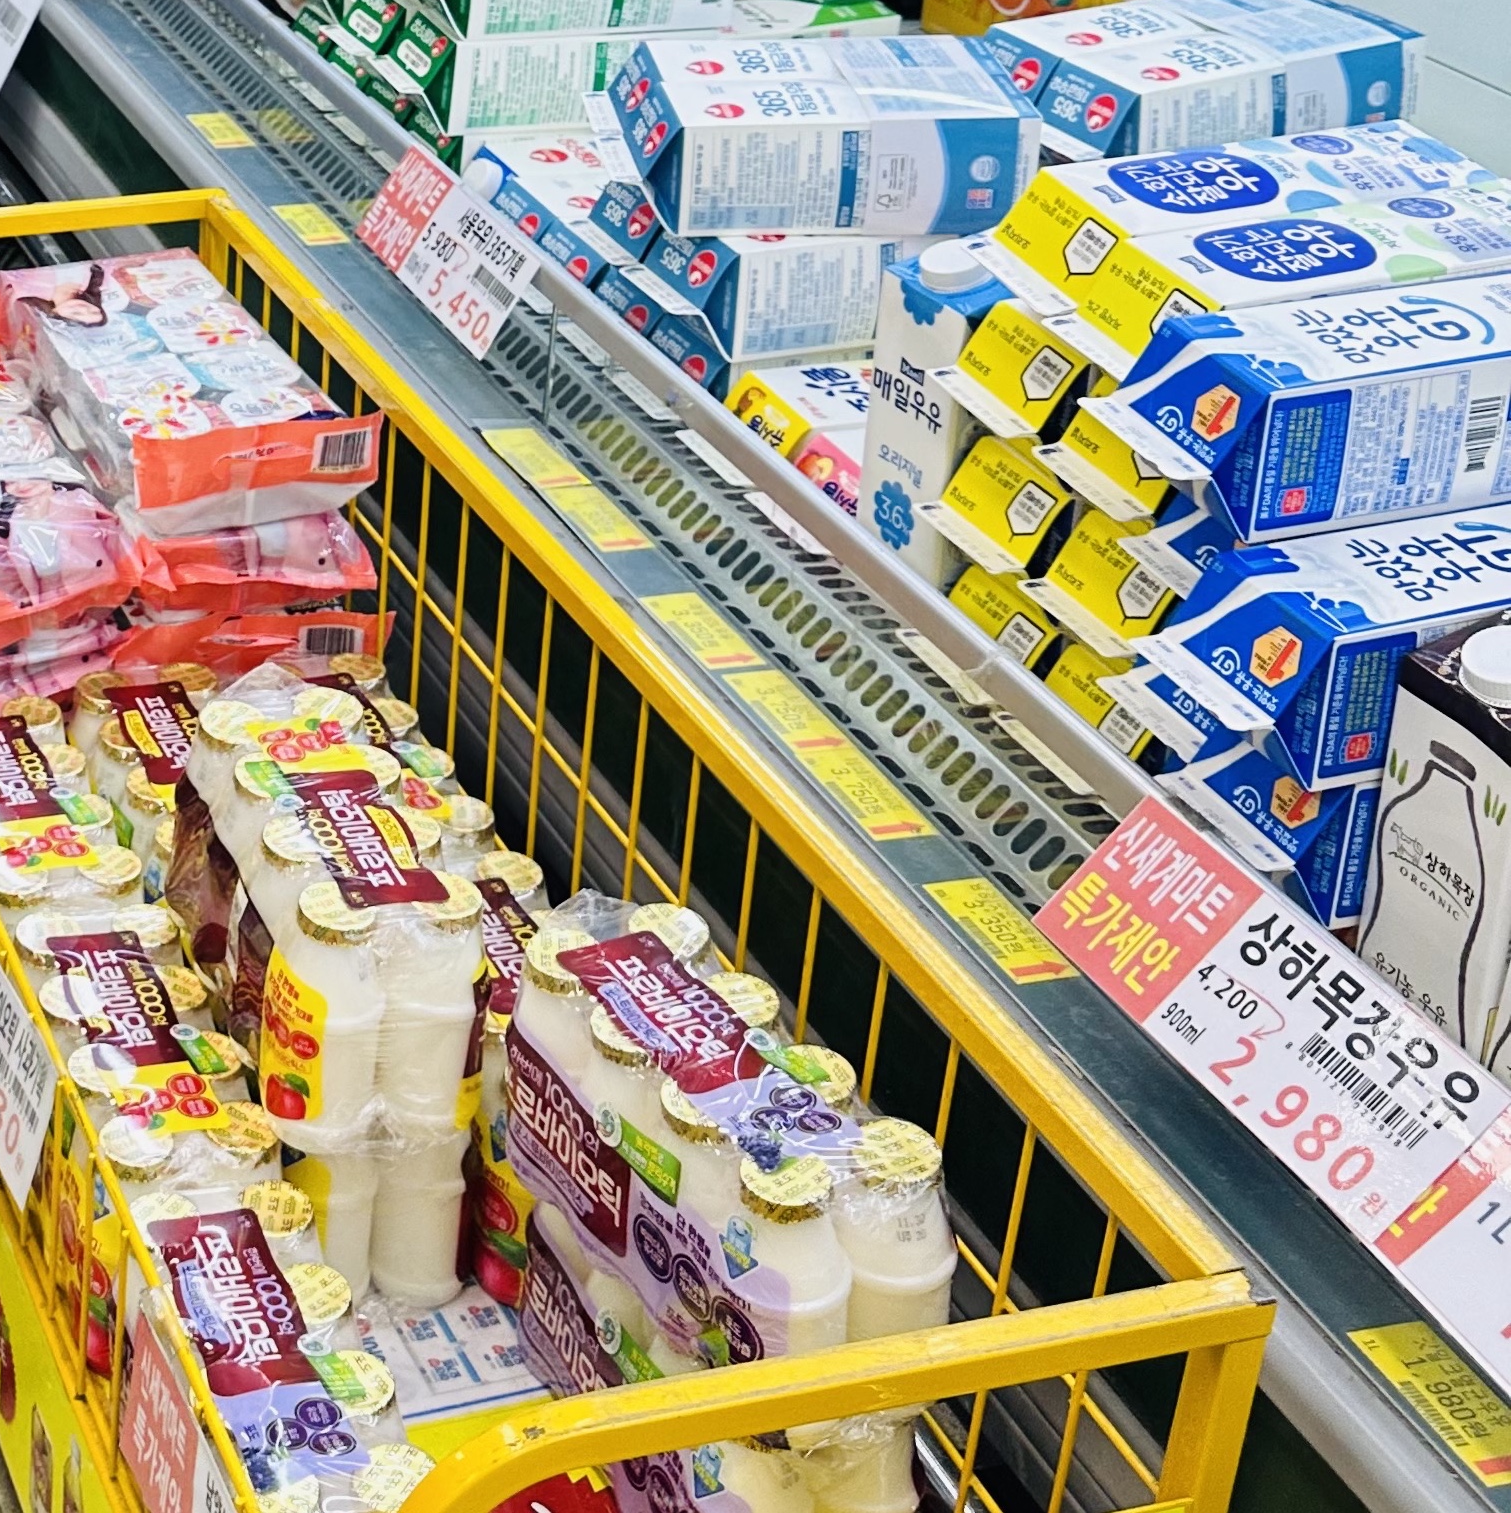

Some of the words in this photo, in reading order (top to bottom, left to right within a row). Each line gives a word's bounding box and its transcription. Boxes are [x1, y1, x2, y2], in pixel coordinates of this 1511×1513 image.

[1090, 15, 1143, 39] 365
[733, 48, 767, 75] 365
[1162, 48, 1221, 74] 365
[752, 90, 790, 118] 365
[1052, 94, 1082, 123] 365
[422, 221, 457, 264] 5,980
[658, 245, 687, 276] 365
[1208, 233, 1276, 275] 소화가
[1288, 223, 1359, 264] 우유
[1292, 308, 1372, 364] 맛있는
[1341, 302, 1419, 357] 우유
[1388, 296, 1472, 342] GT
[872, 367, 943, 434] 매일우유
[1155, 412, 1178, 433] GT
[878, 442, 923, 489] 오리지널
[1345, 538, 1433, 603] 맛있는
[1399, 535, 1481, 594] 우유
[321, 787, 406, 889] 프로바이오틱
[1104, 816, 1235, 935] 신세계마트
[1398, 865, 1462, 922] ORGANIC
[1425, 849, 1477, 908] 상하목장
[1060, 873, 1183, 996] 특가제안
[87, 948, 157, 1049] 프로바이오틱
[613, 953, 731, 1066] 프로바이오틱
[1197, 960, 1259, 1020] 4,200
[1371, 952, 1415, 999] 유기농
[1416, 992, 1448, 1026] 우유
[1161, 1001, 1208, 1045] 900ml
[1239, 912, 1481, 1129] 상하목장우유
[543, 1072, 602, 1152] 1000억
